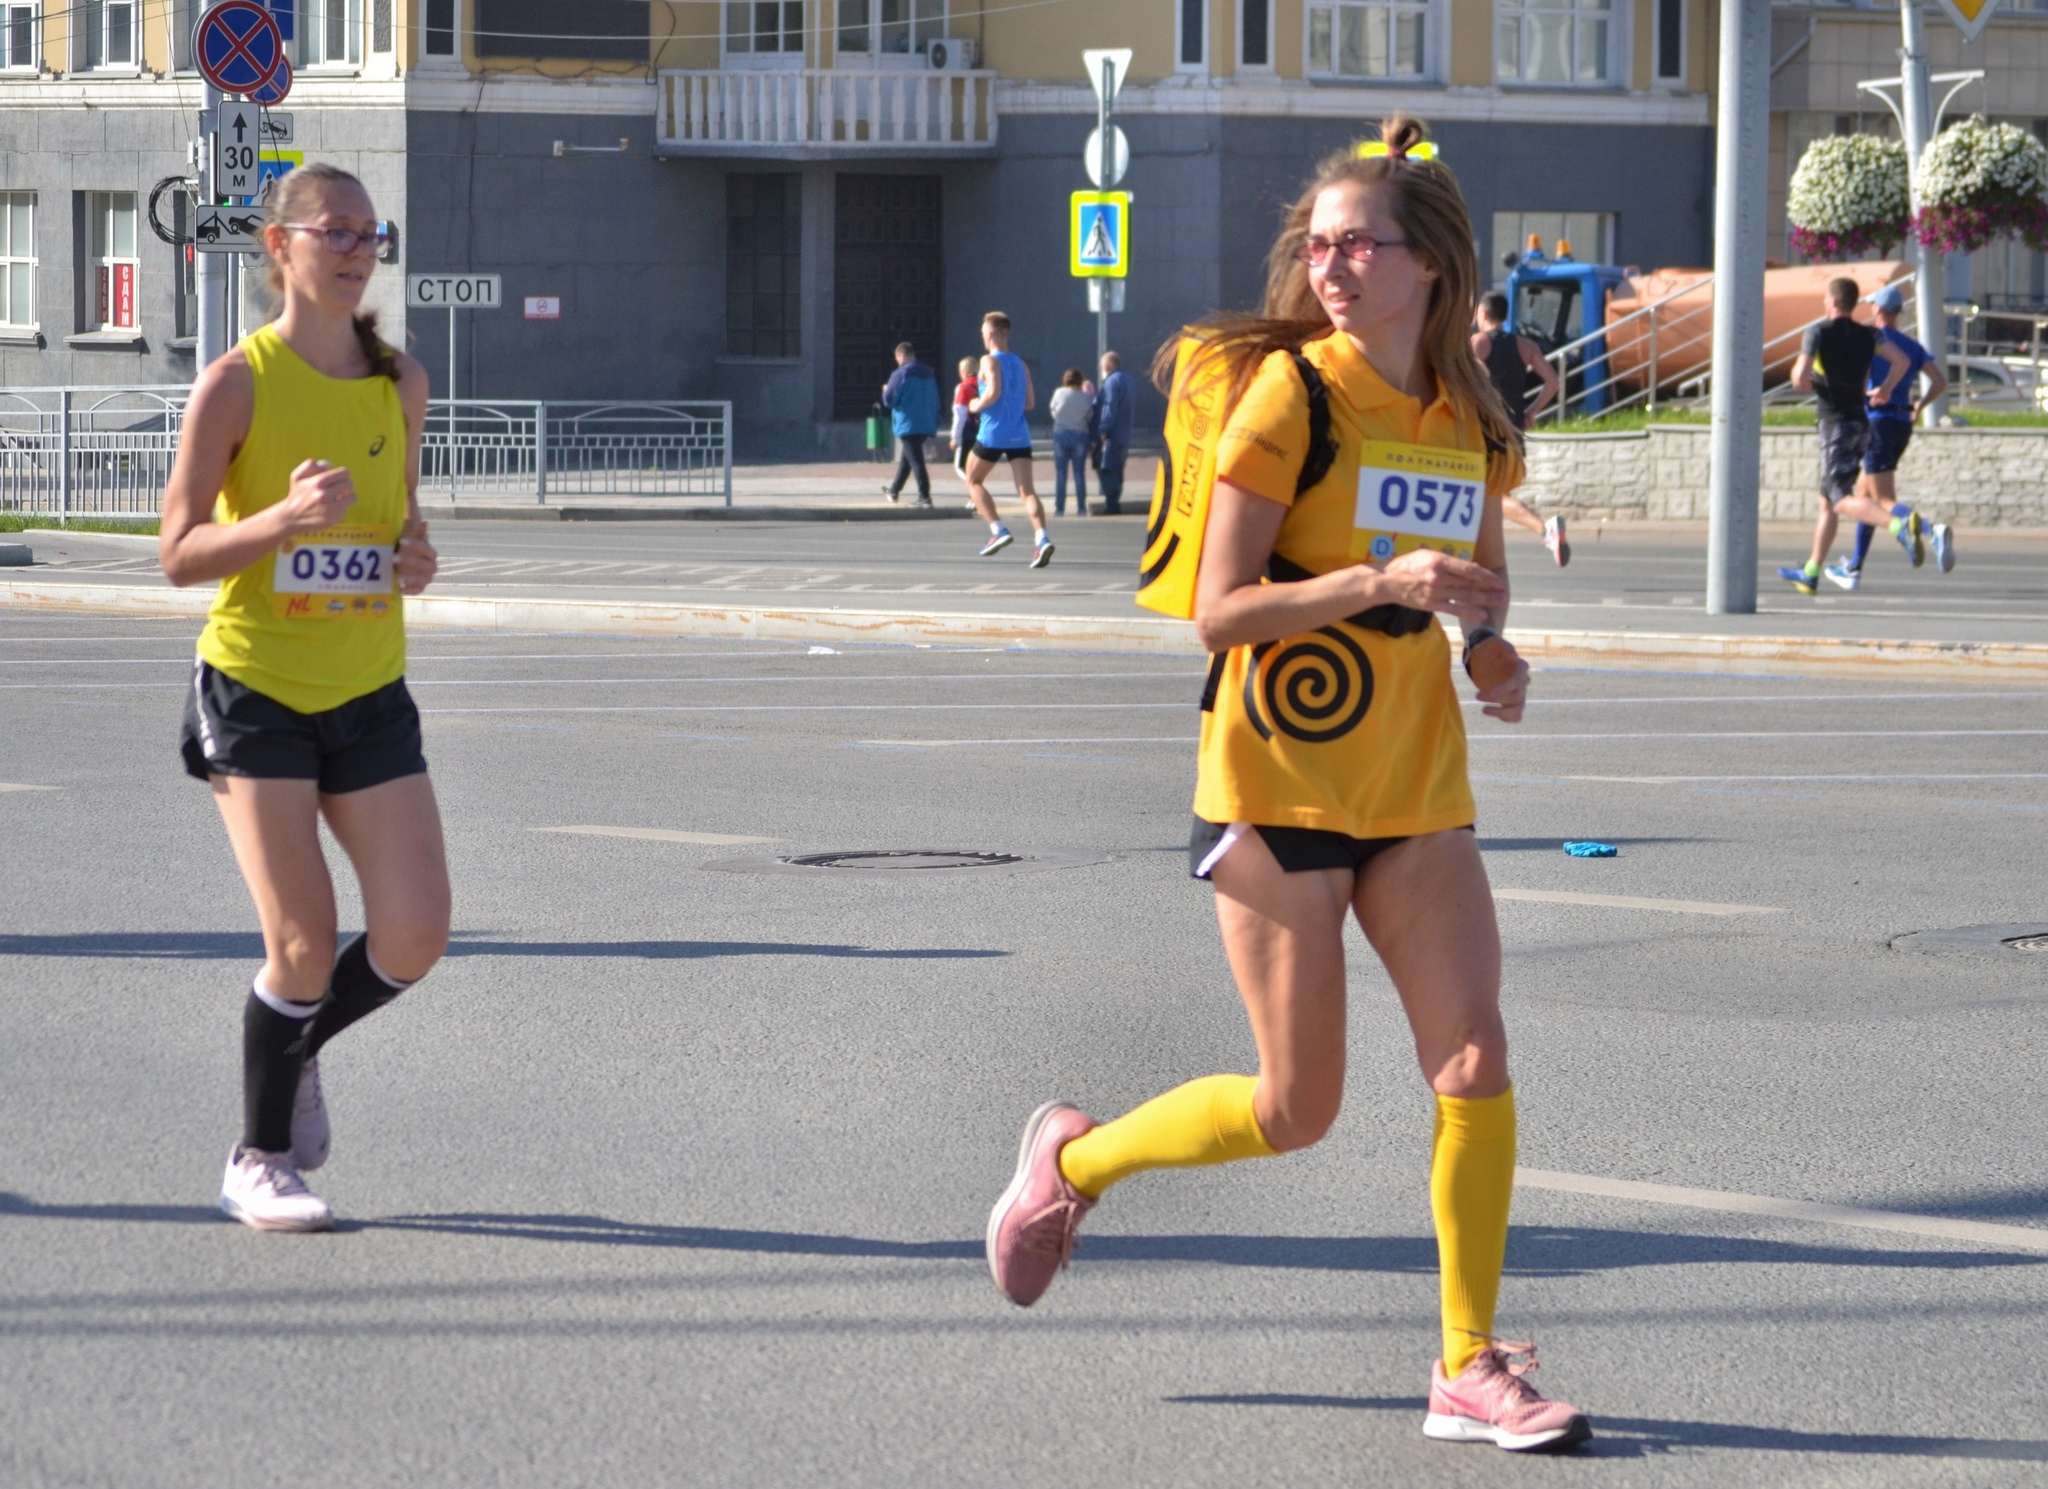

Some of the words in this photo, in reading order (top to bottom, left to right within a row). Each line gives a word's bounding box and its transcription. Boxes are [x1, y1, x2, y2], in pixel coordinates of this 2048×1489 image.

[224, 146, 254, 170] 30
[121, 266, 130, 326] СДАМ
[418, 278, 492, 302] СТОП
[1379, 475, 1476, 528] 0573
[293, 549, 380, 581] 0362
